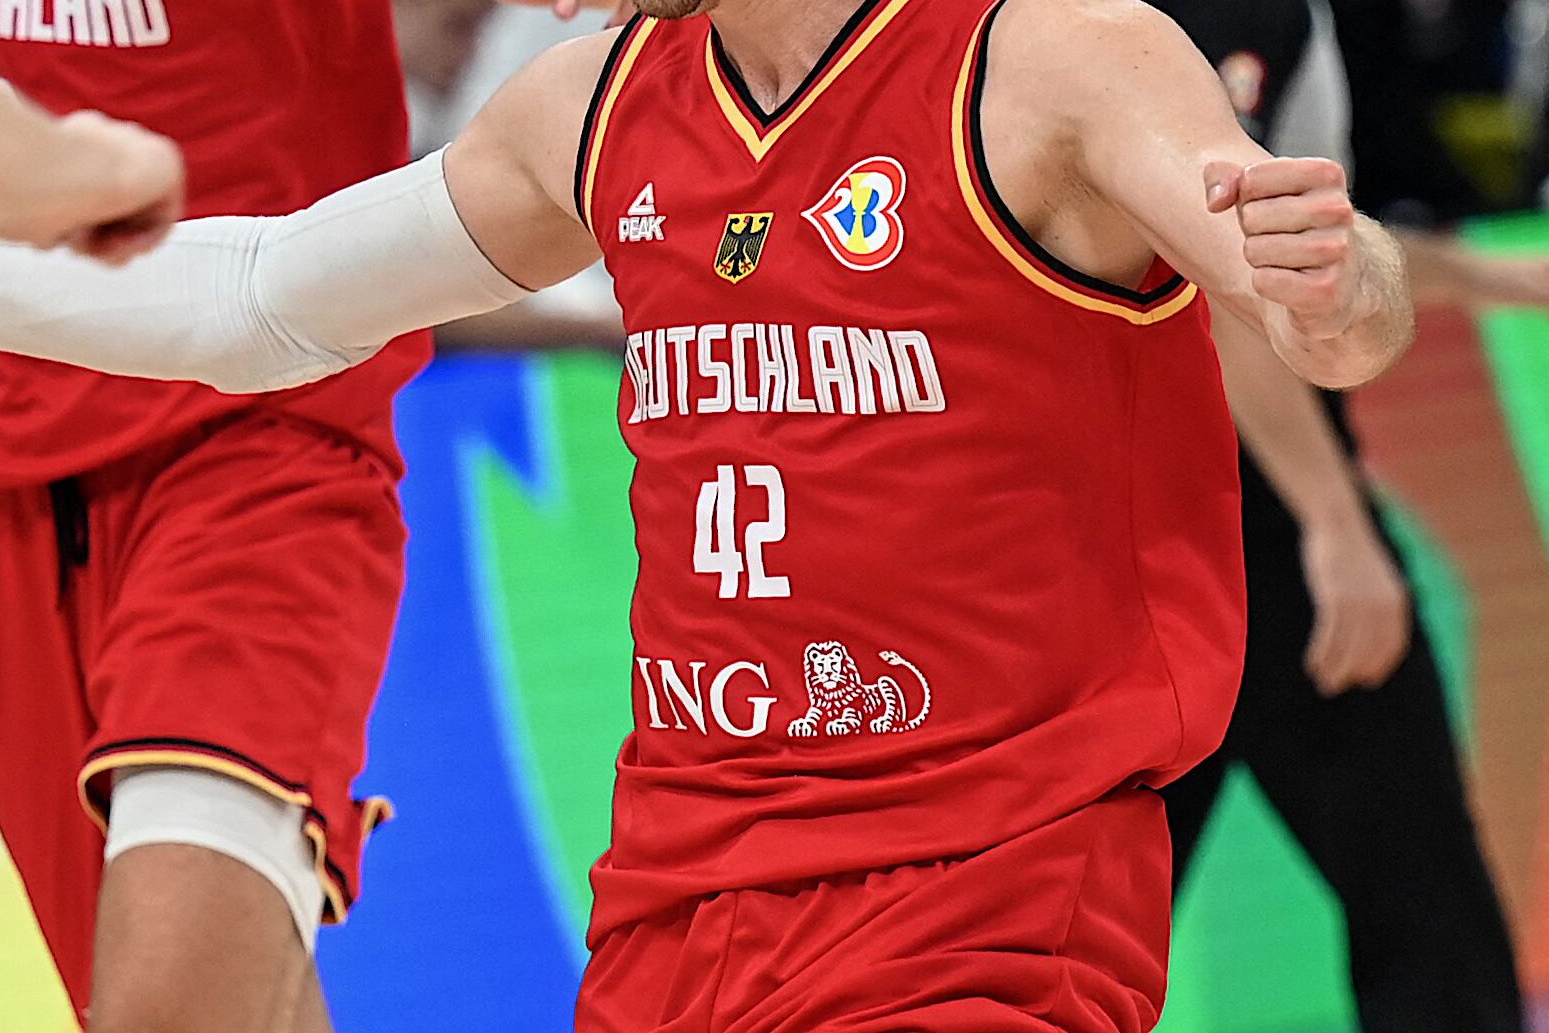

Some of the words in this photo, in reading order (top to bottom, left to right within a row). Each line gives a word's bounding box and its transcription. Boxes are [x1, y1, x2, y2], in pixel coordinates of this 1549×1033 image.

[618, 215, 667, 243] PEAK
[693, 465, 791, 599] 42
[636, 656, 778, 738] ING
